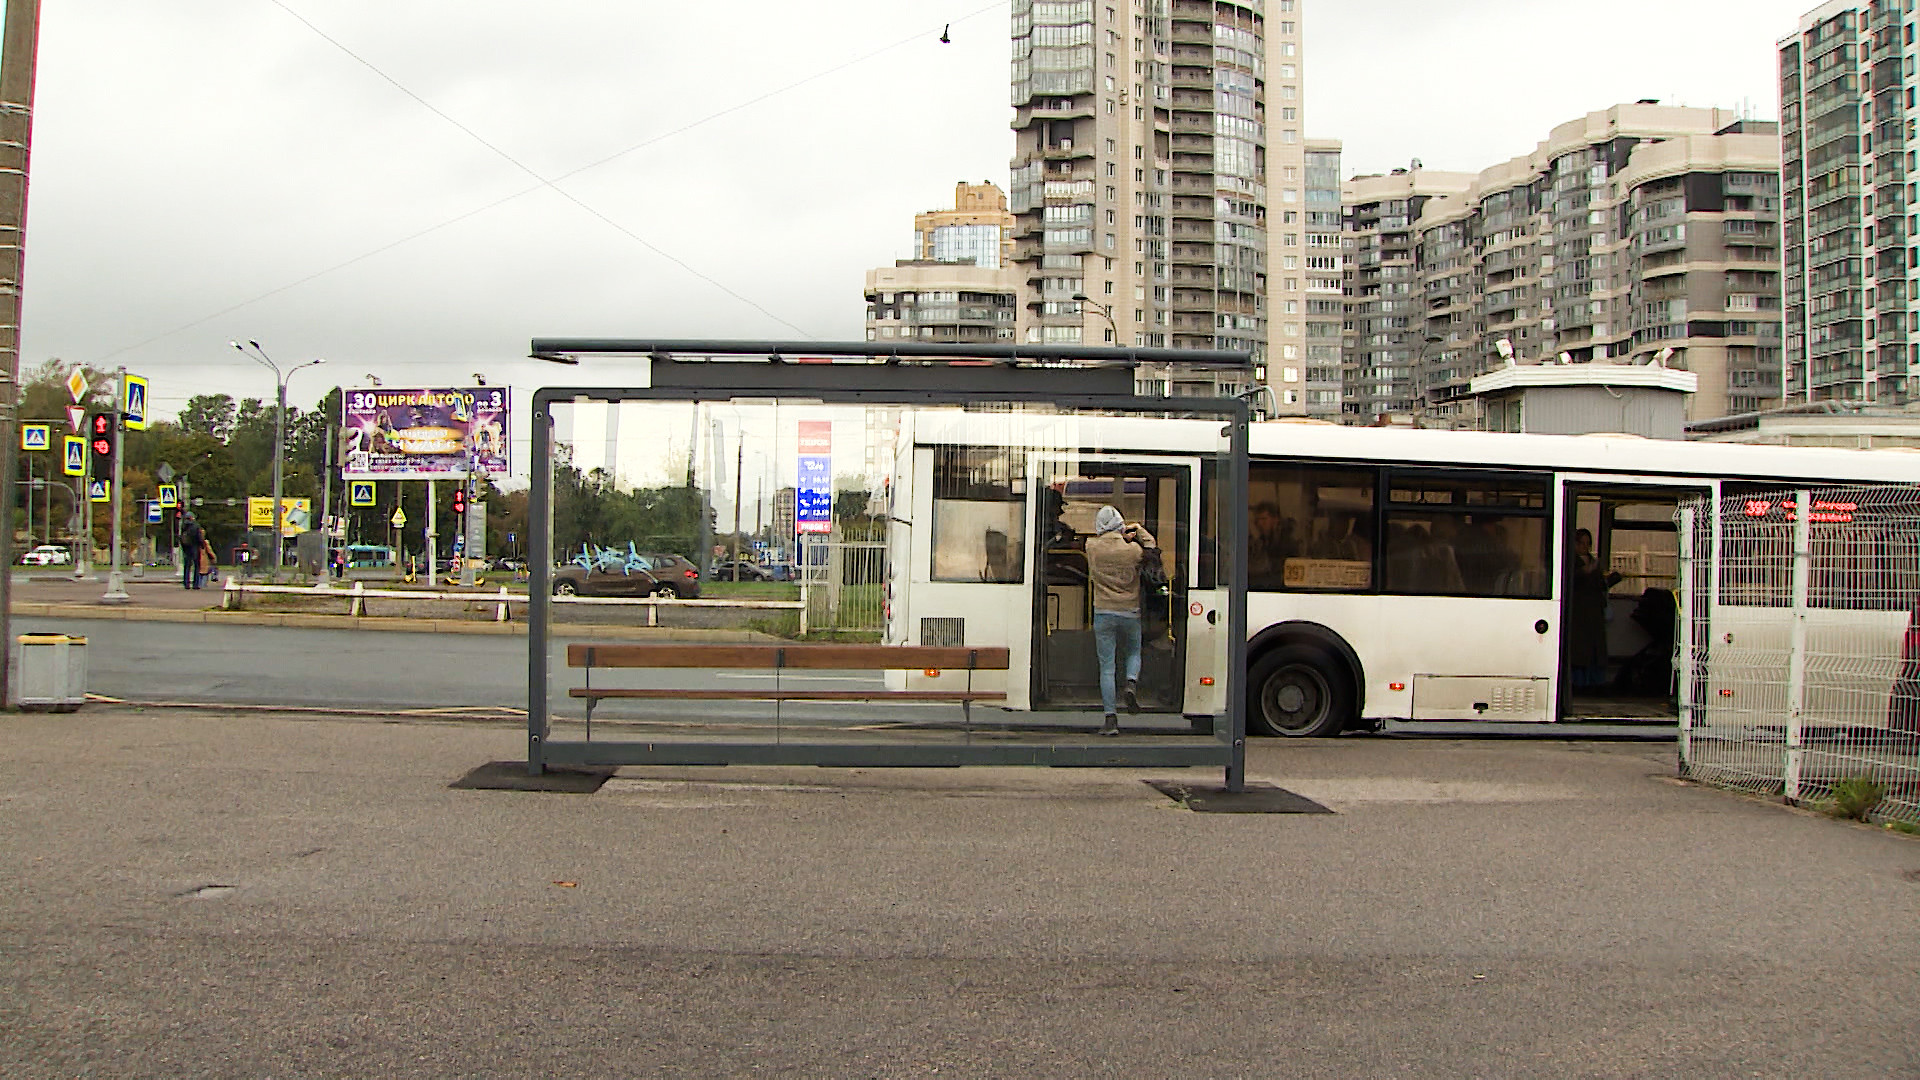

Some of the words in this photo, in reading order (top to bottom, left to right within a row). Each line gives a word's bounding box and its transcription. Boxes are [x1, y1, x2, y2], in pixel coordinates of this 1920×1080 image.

[354, 393, 377, 409] 30
[378, 394, 415, 407] ЦИРК
[490, 391, 502, 407] 3
[1746, 500, 1771, 516] 397
[1286, 565, 1305, 581] 397
